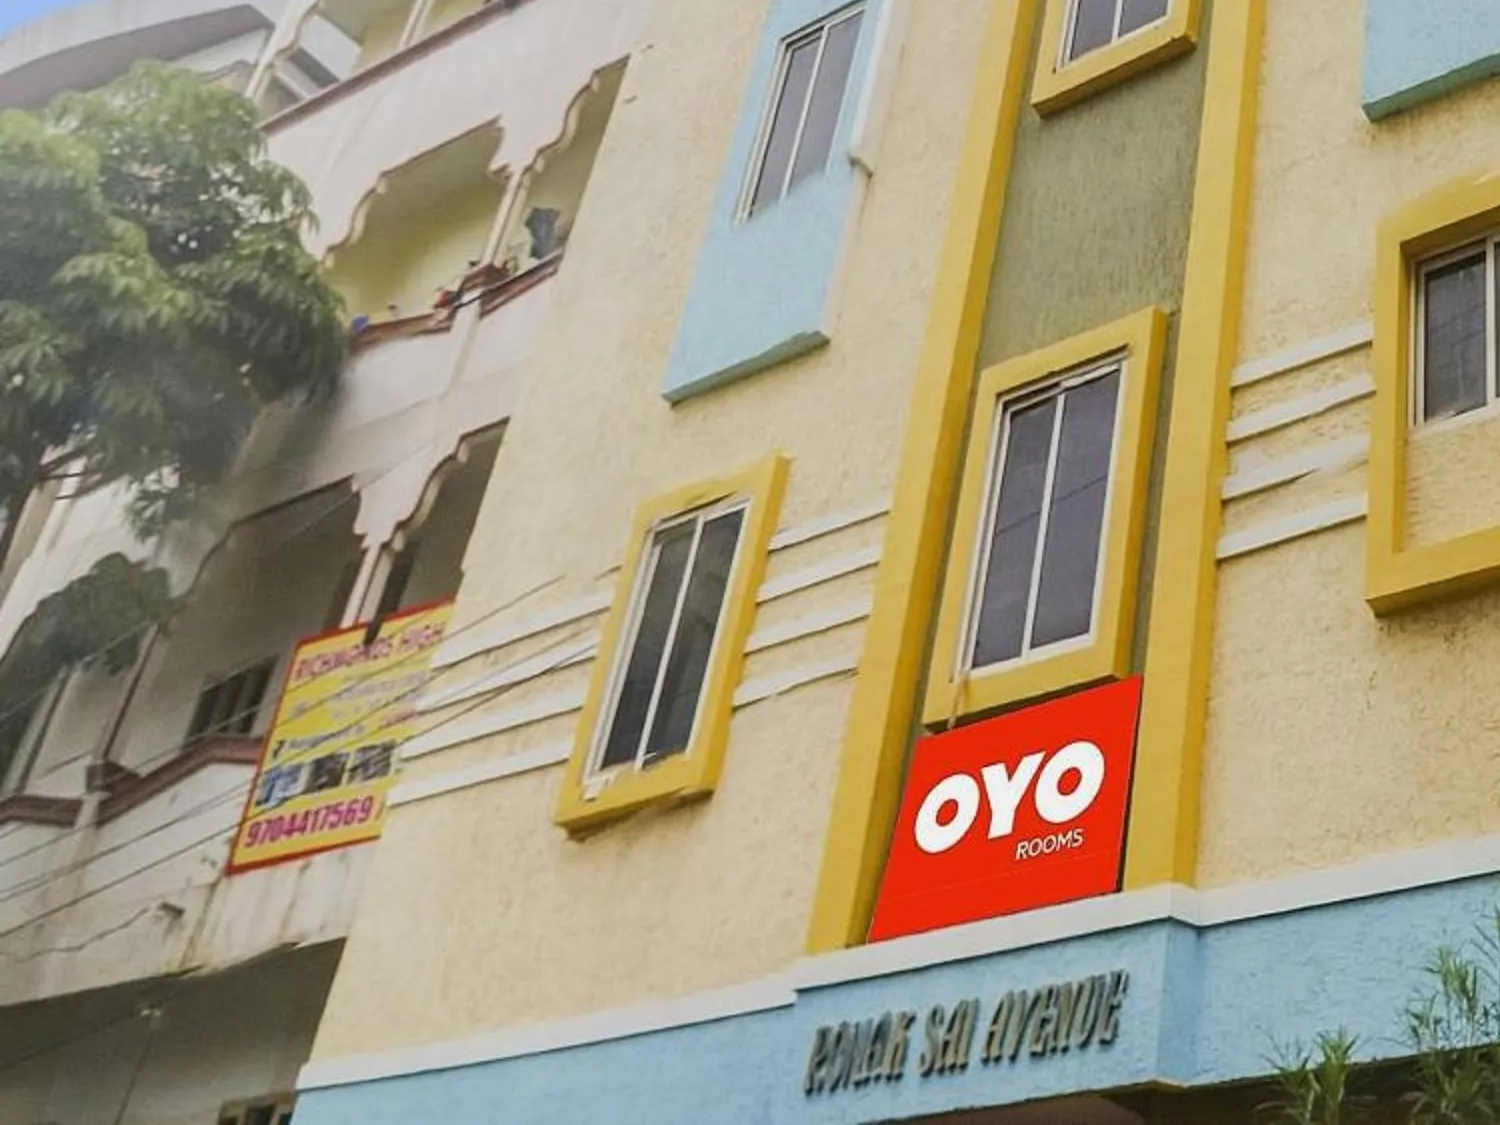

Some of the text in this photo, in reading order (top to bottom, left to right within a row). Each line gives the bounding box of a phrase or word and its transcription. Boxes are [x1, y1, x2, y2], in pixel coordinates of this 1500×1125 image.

[915, 741, 1105, 854] OYO
[1015, 828, 1085, 861] ROOMS
[919, 996, 981, 1079] SAI
[980, 969, 1130, 1065] AVENUE
